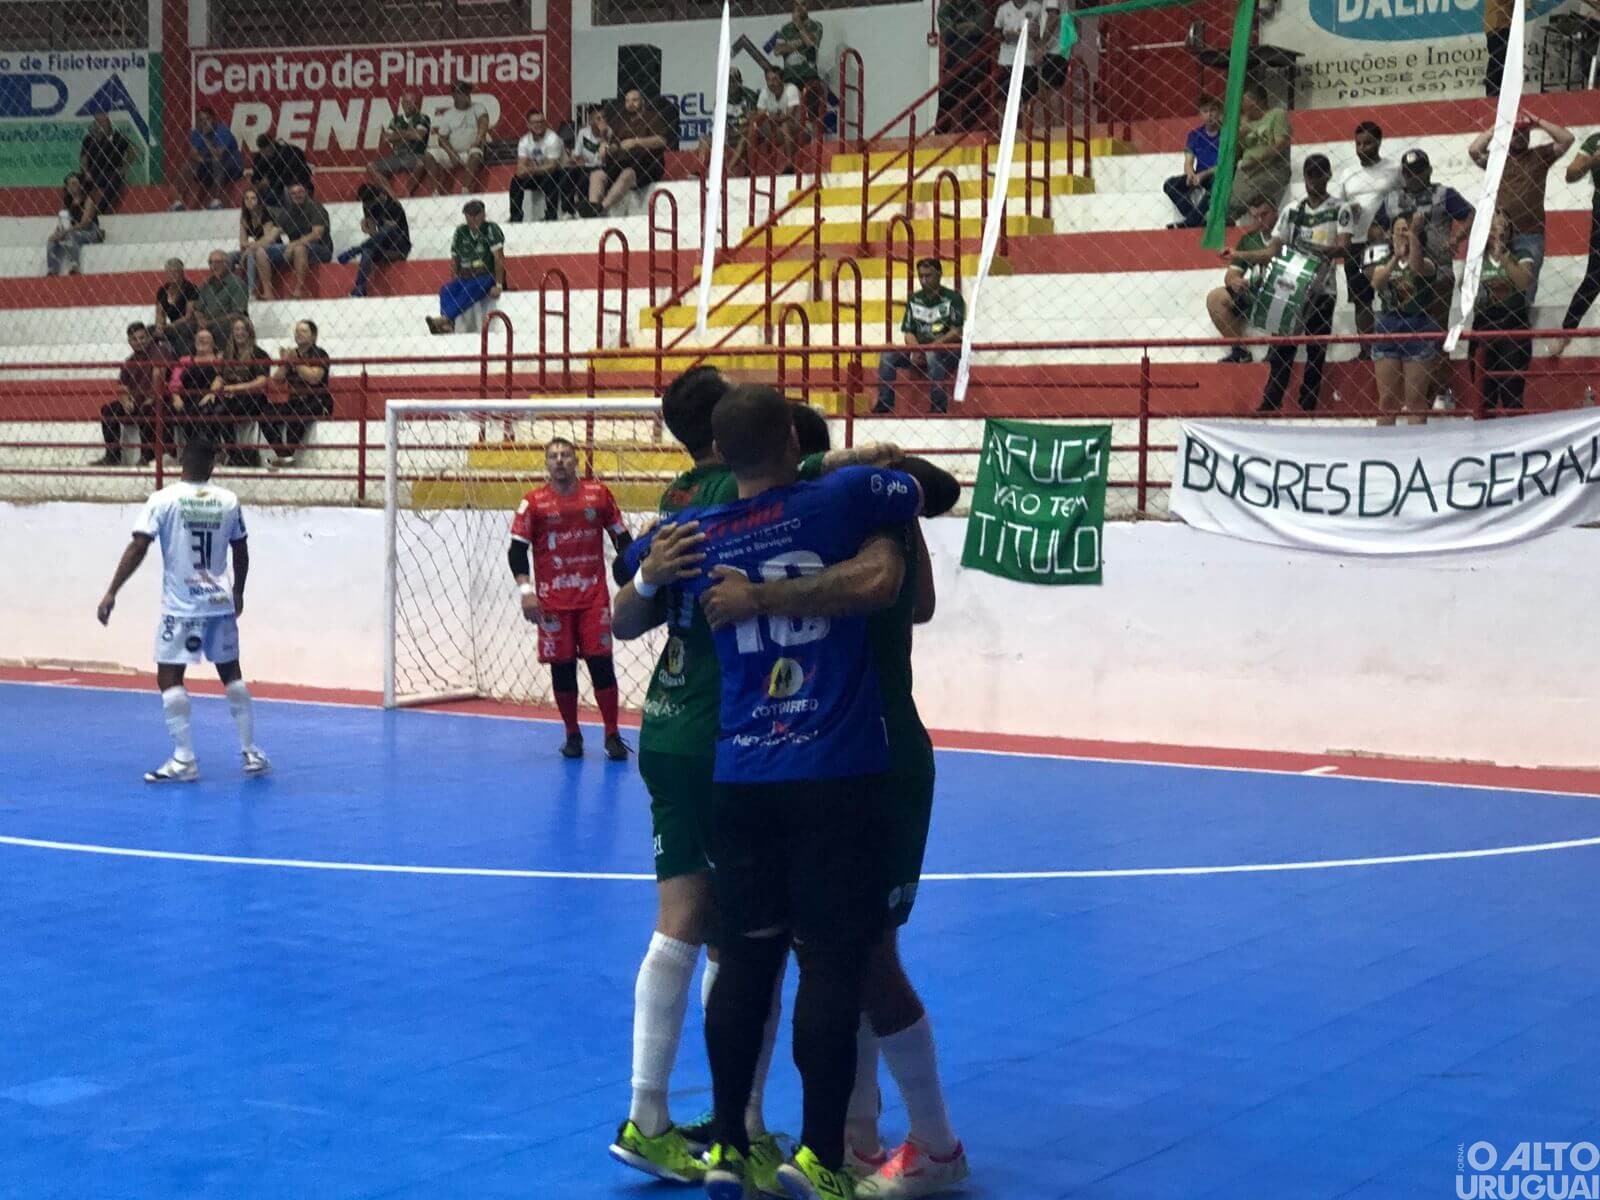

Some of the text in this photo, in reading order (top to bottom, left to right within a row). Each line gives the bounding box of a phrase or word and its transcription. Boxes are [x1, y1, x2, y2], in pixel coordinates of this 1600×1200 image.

[20, 55, 42, 70] de
[48, 52, 147, 72] Fisioterapia
[197, 49, 541, 95] Centro de Pinturas
[1406, 54, 1417, 68] e
[1427, 46, 1487, 65] Incor
[986, 431, 1101, 483] AFUCS
[1183, 436, 1600, 518] BUGRES DA GERAL
[191, 530, 213, 570] 31
